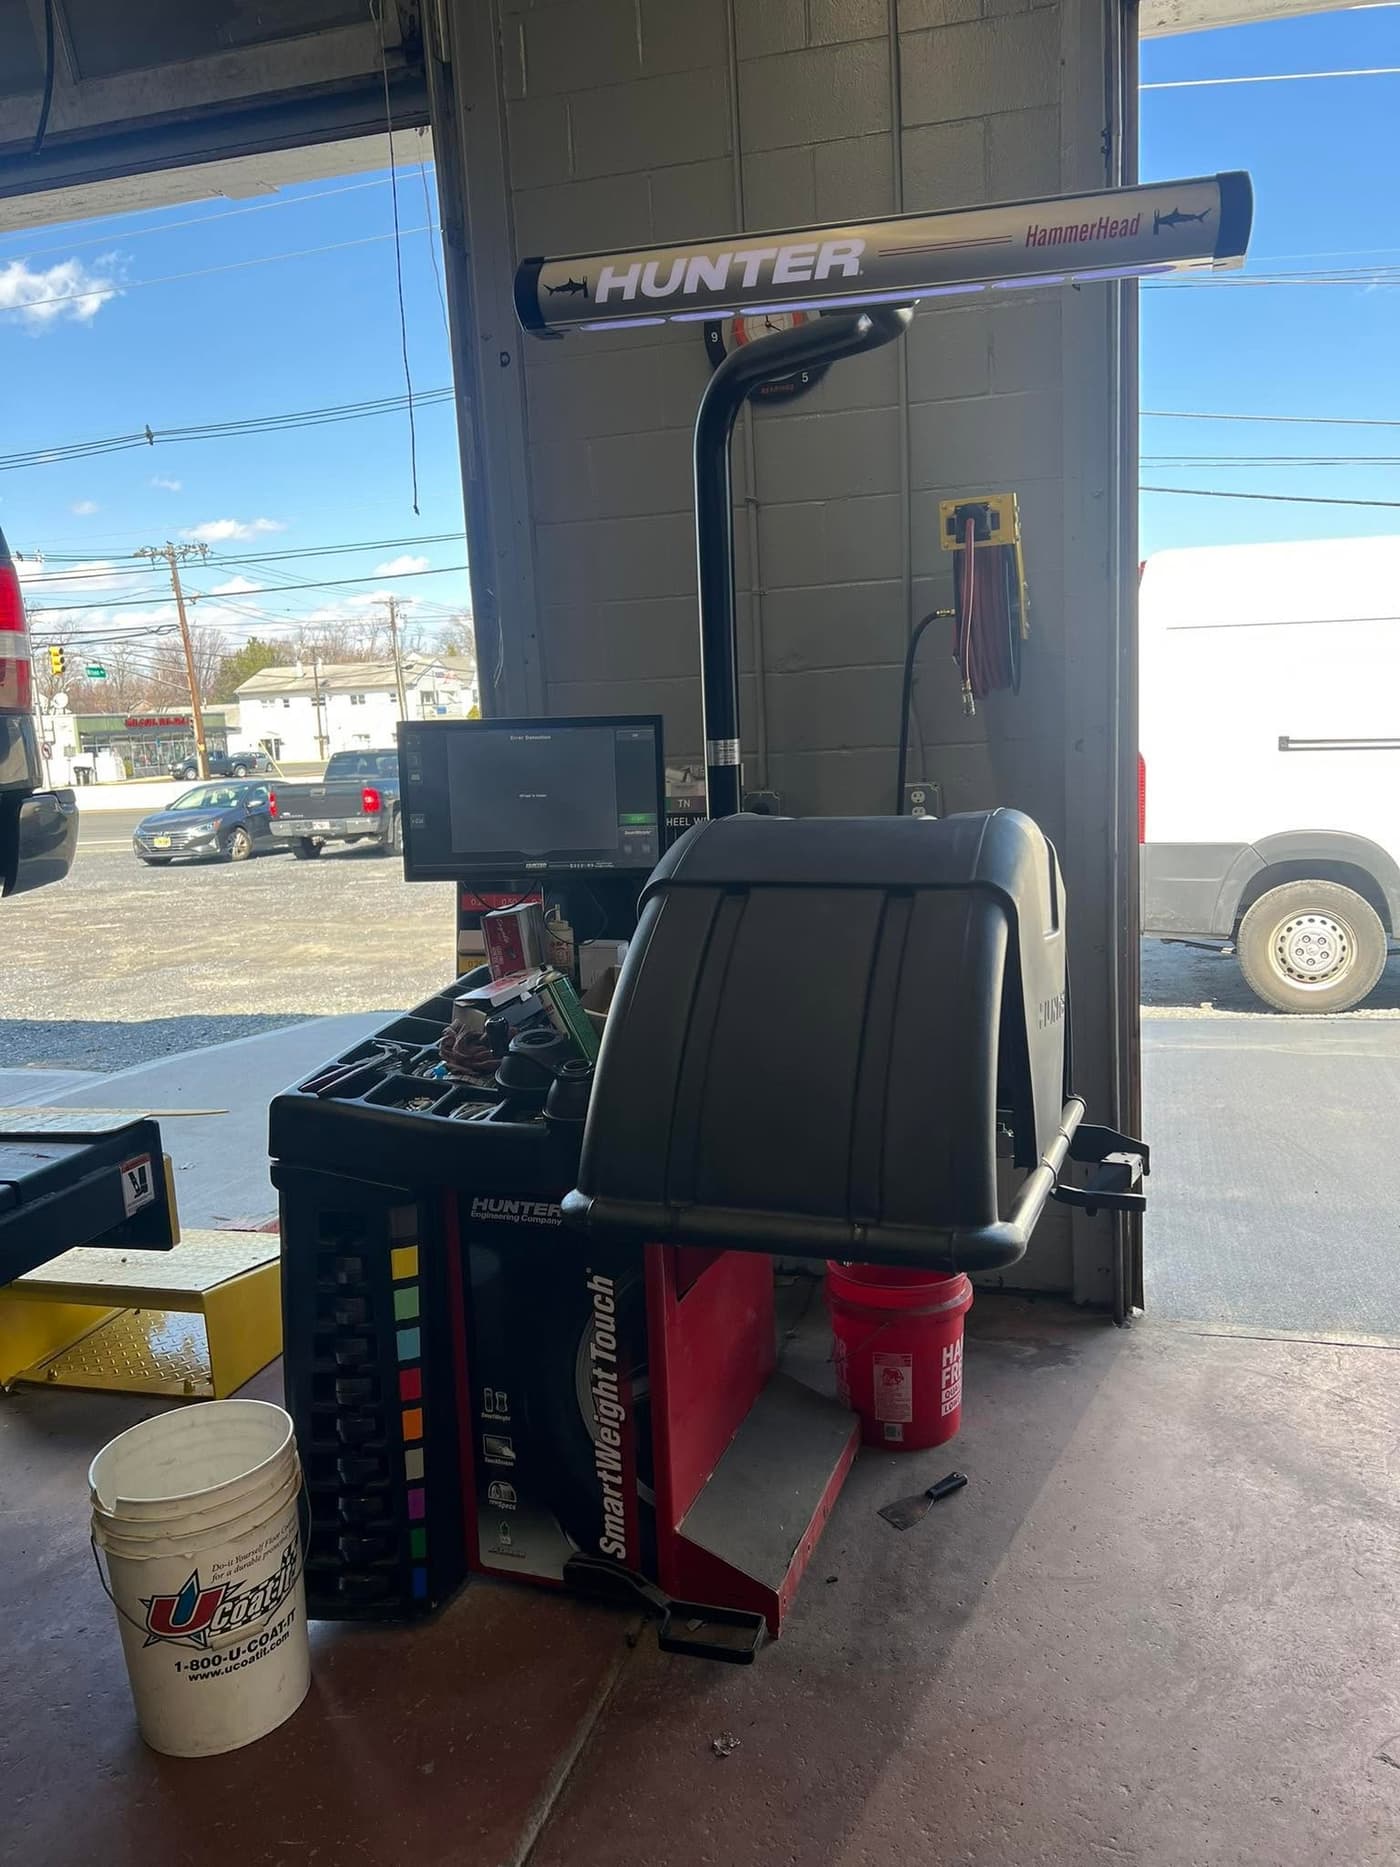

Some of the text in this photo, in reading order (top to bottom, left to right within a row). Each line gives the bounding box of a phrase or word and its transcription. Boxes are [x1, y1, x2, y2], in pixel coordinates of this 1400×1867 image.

[1025, 212, 1142, 248] HammerHead
[595, 239, 866, 304] HUNTER
[711, 331, 719, 343] 9
[801, 372, 809, 383] 5
[472, 1198, 561, 1217] HUNTER
[470, 1210, 562, 1226] Engineering Company
[587, 1274, 626, 1559] SmartWeight Touch
[211, 1560, 234, 1573] Do-it
[211, 1572, 225, 1584] for
[226, 1569, 233, 1577] a
[174, 1607, 297, 1673] 1-800-U-COAT-IT
[188, 1631, 291, 1682] www.ucoatit.com
